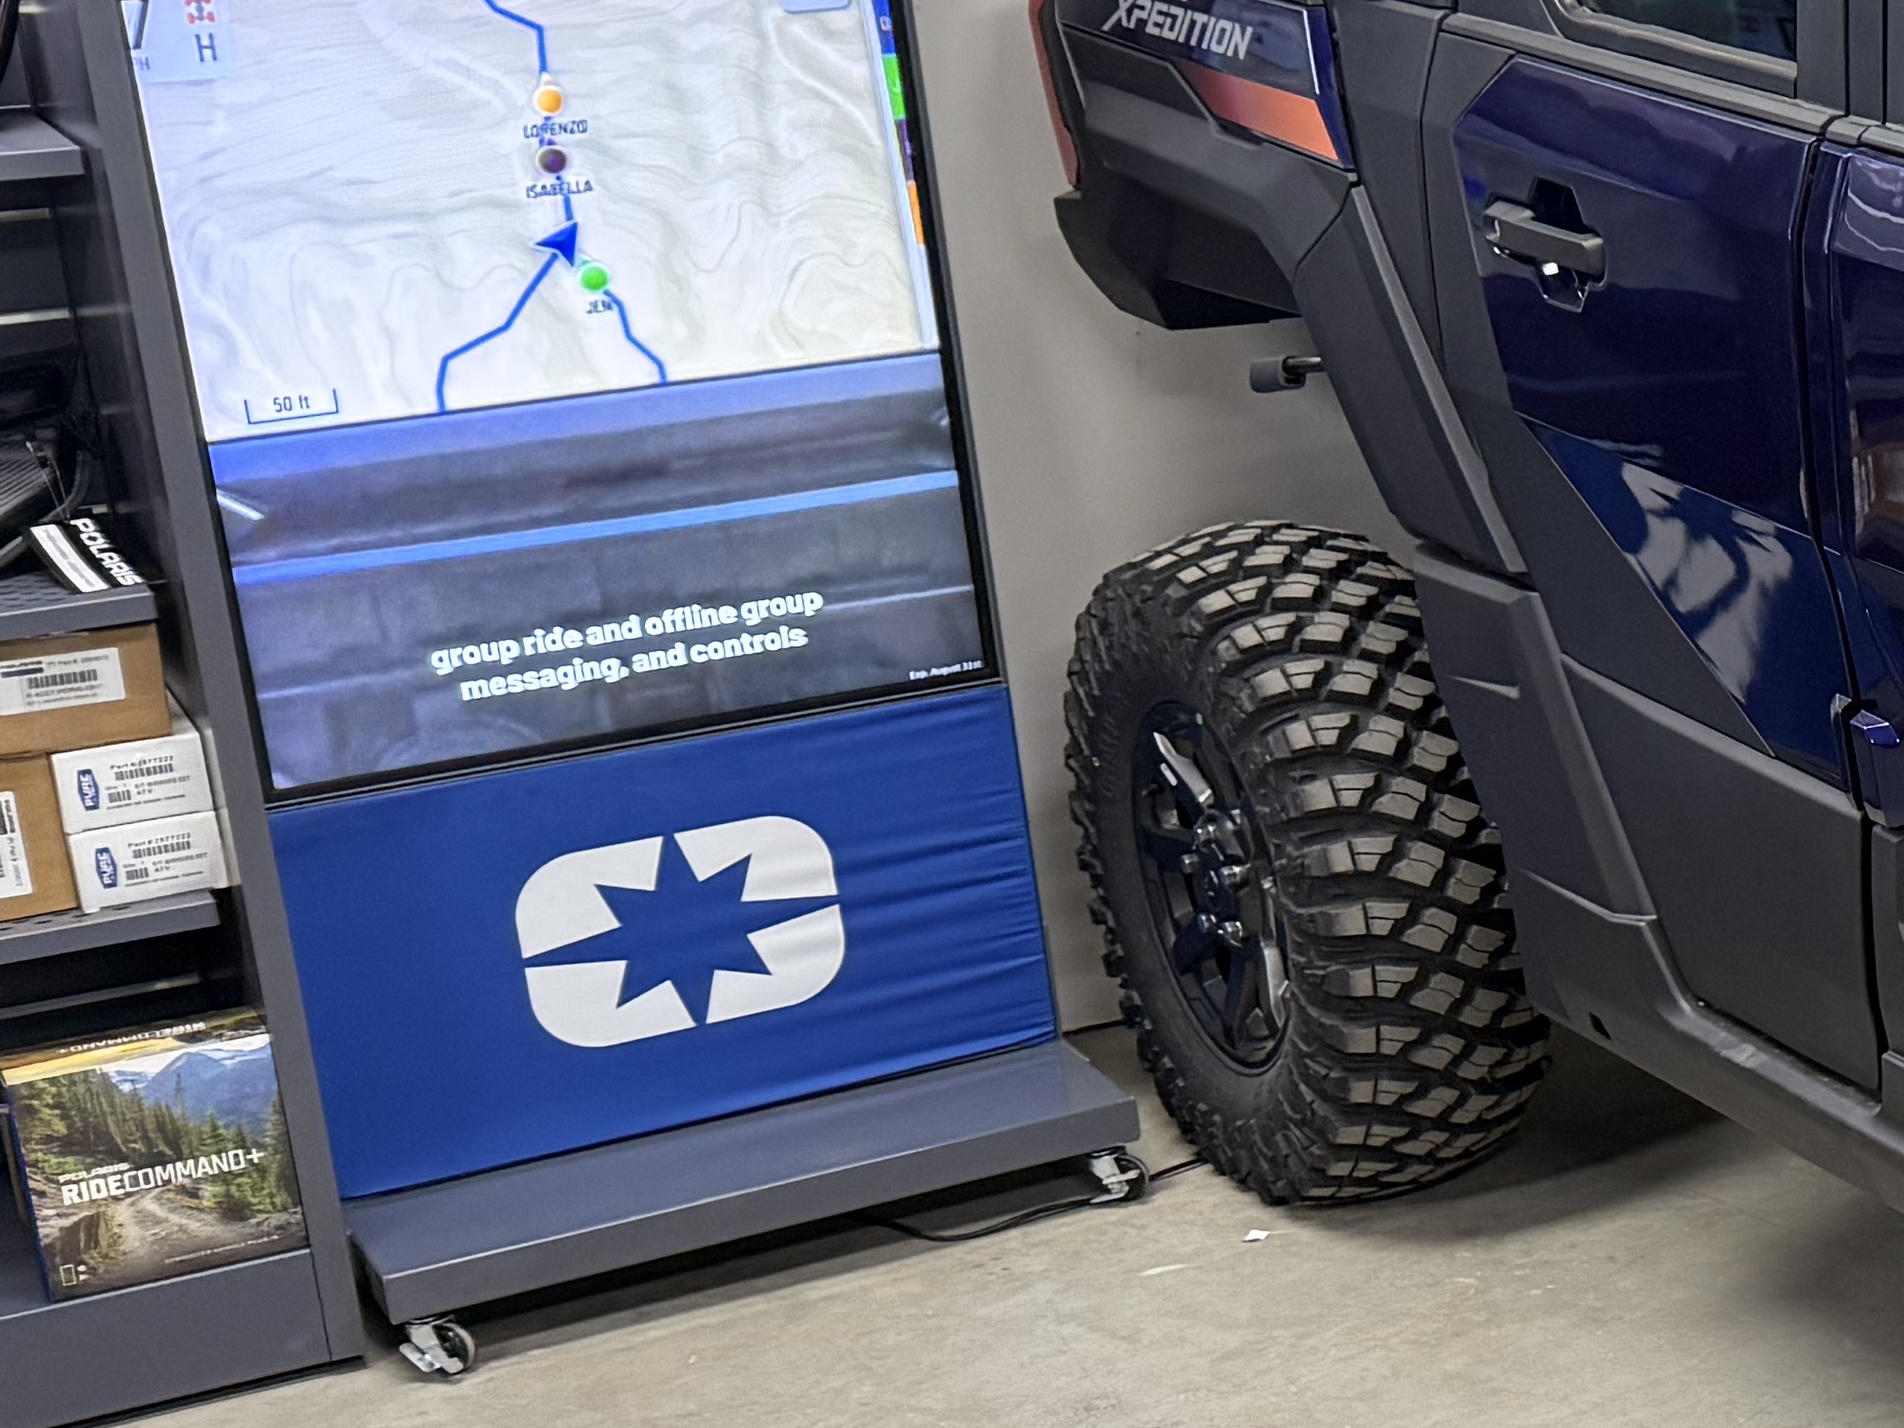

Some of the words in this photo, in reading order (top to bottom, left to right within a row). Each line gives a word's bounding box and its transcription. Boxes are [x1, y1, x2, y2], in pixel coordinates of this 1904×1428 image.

[195, 32, 217, 62] H
[523, 119, 588, 139] LORENZO
[526, 180, 594, 199] ISABELLA
[273, 396, 293, 413] 50
[69, 517, 148, 586] POLARIS
[430, 638, 521, 675] group
[523, 627, 584, 656] ride
[586, 614, 642, 646] and
[644, 603, 738, 636] offline
[740, 590, 824, 626] group
[459, 656, 630, 702] messaging,
[631, 642, 688, 673] and
[689, 625, 809, 665] controls
